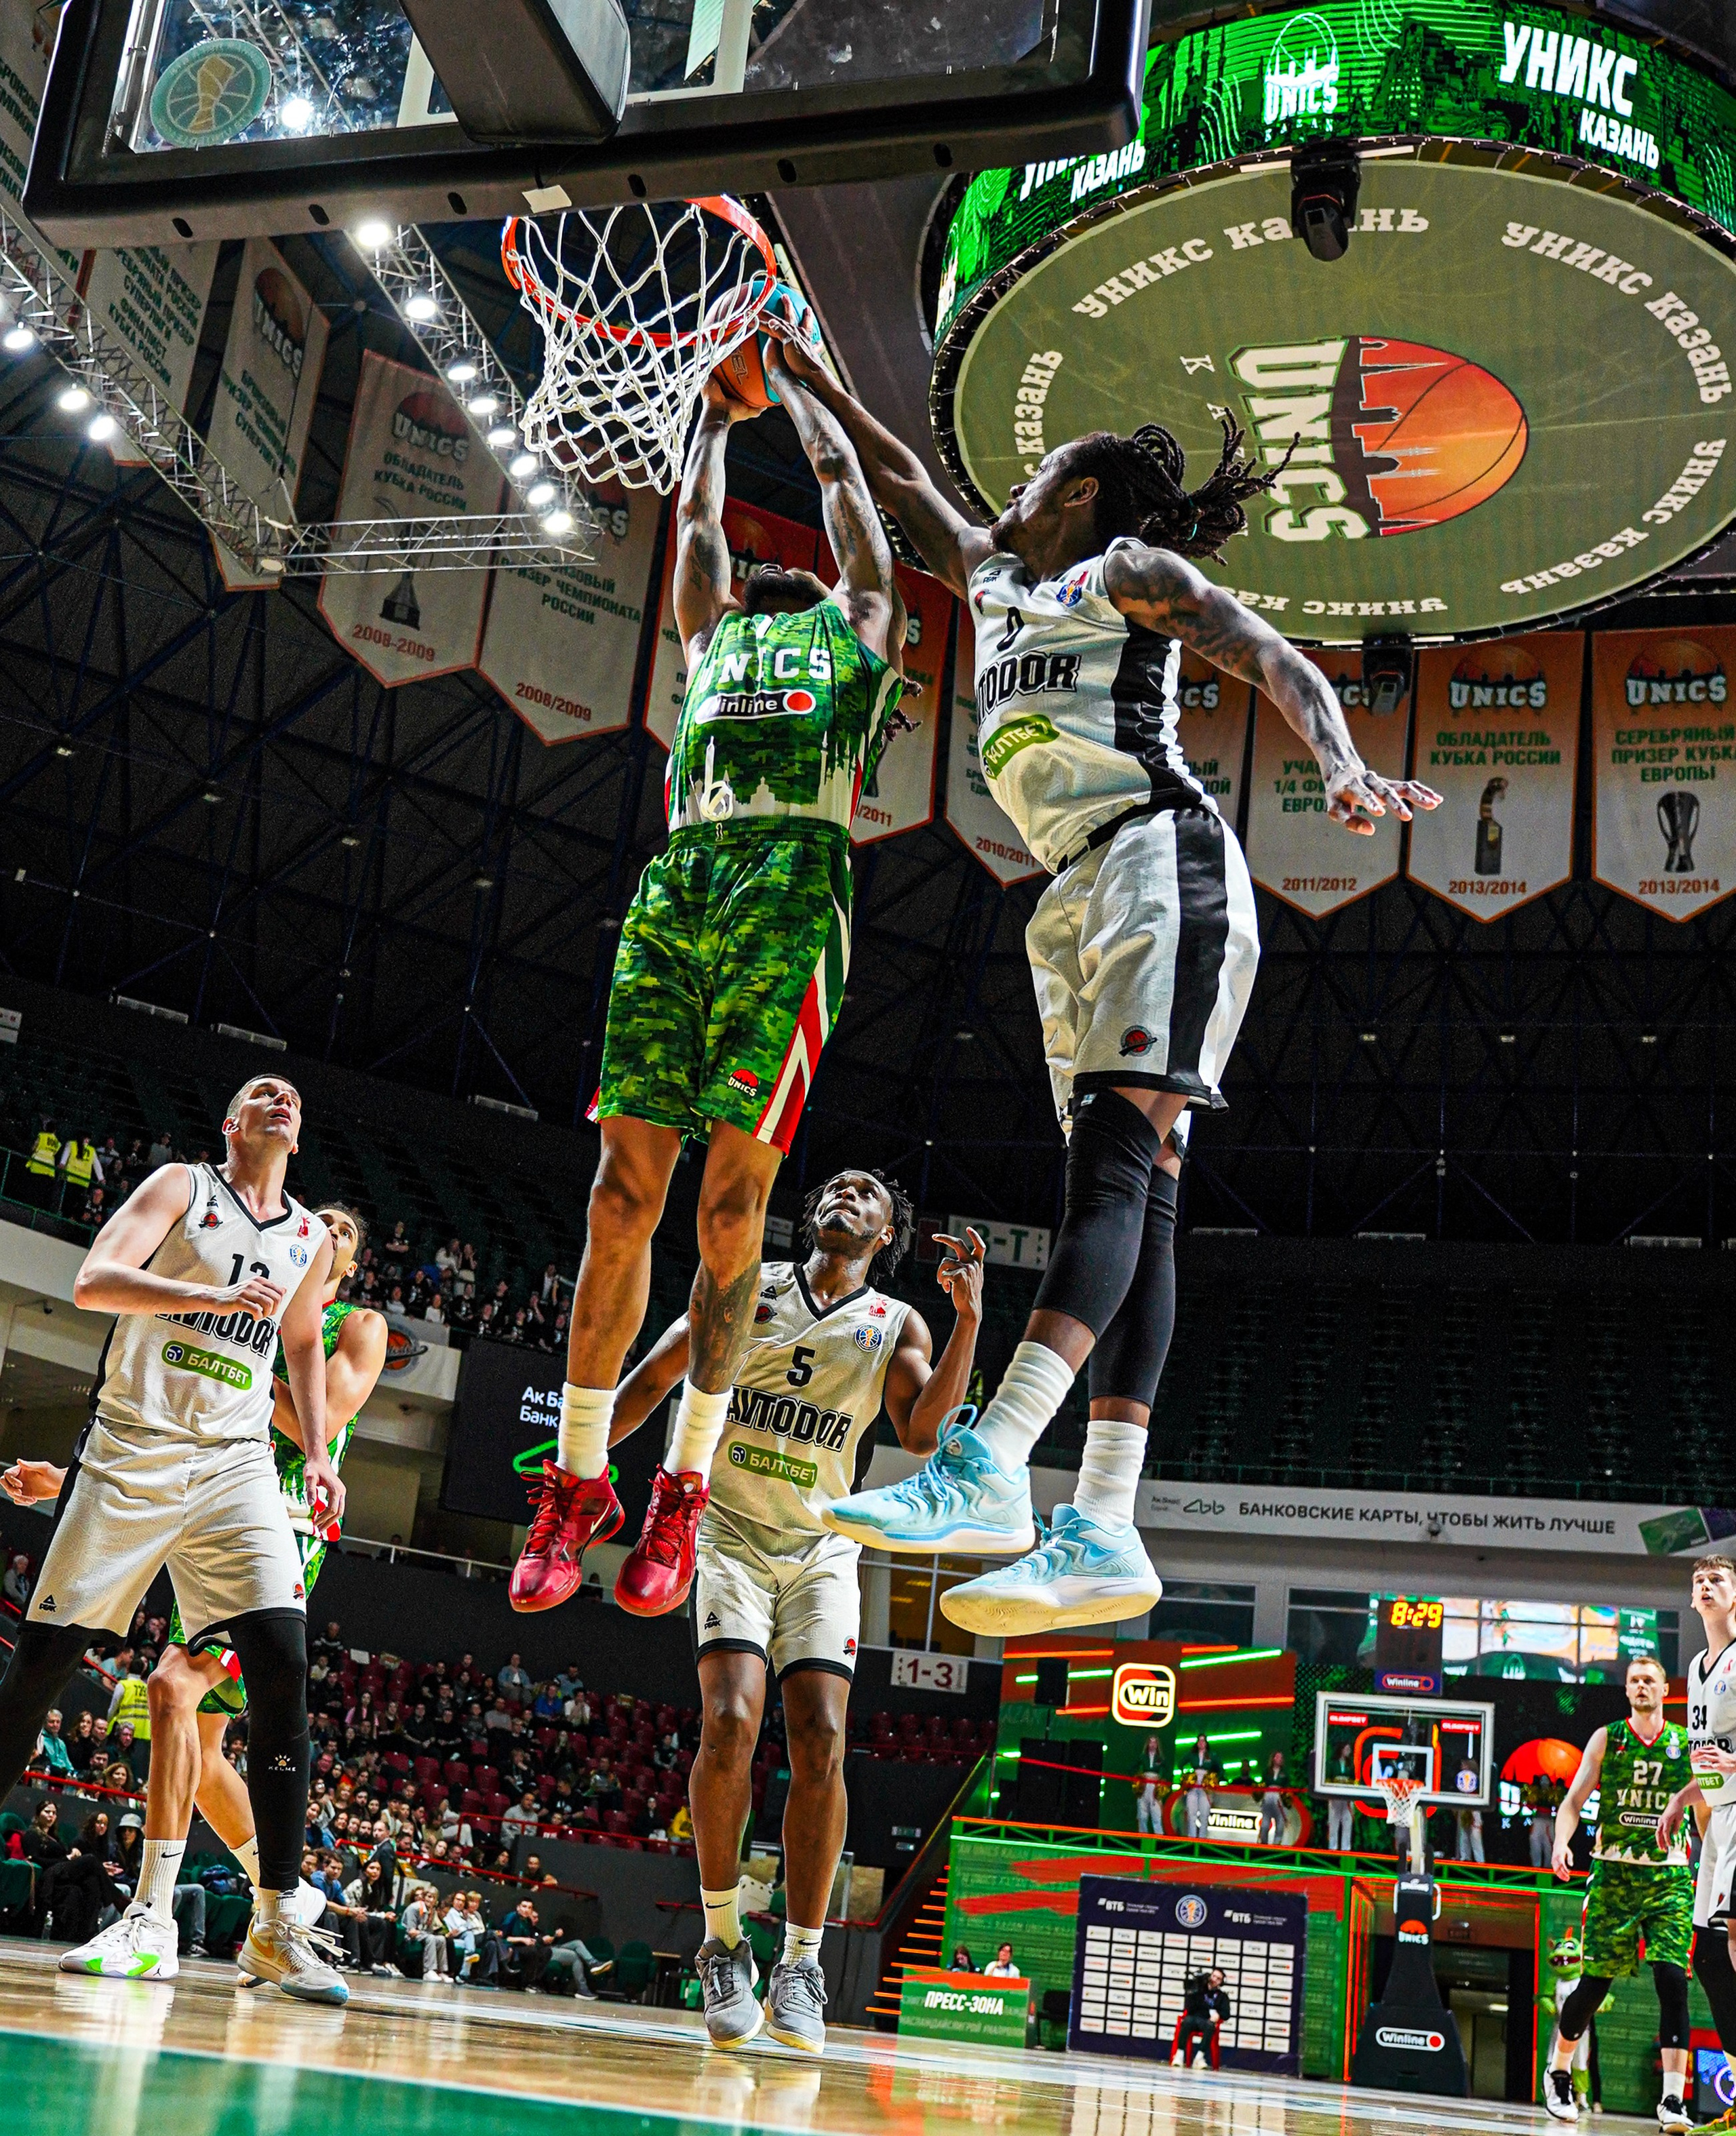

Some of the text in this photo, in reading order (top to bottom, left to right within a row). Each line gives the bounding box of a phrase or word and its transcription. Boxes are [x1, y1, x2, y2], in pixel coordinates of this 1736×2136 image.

[1499, 21, 1638, 117] УНИКС
[1263, 73, 1339, 125] UNICS
[1580, 108, 1660, 170] КАЗАНЬ
[1070, 140, 1146, 203] КАЗАНЬ
[1224, 208, 1429, 250] кань
[393, 411, 470, 462] UNICS
[1229, 336, 1370, 542] UNICS
[374, 471, 467, 512] КУБКА РОССИИ
[542, 593, 595, 625] РОССИИ
[556, 580, 641, 622] ЧЕМПИОНАТА
[351, 624, 435, 662] 2008-2009
[515, 682, 592, 723] 2008/2009
[1451, 680, 1546, 708] UNICS
[1627, 675, 1727, 706] UNICS
[717, 697, 778, 714] inline
[1436, 731, 1552, 749] ОБЛАДАТЕЛЬ
[1615, 725, 1735, 745] СЕРЕБРЯНЫЙ
[1431, 751, 1560, 765] КУБКА РОССИИ
[1612, 747, 1679, 764] ПРИЗЕР
[1641, 766, 1716, 782] ЕВРОПЫ
[1275, 780, 1296, 795] 1/4
[856, 804, 892, 827] /2011
[1282, 877, 1357, 892] 2011/2012
[1448, 879, 1527, 895] 2013/2014
[1638, 878, 1720, 894] 2013/2014
[728, 1077, 757, 1097] UNICS
[187, 1352, 249, 1385] БАЛТБЕТ
[786, 1345, 815, 1387] 5
[521, 1386, 564, 1409] Ак Ба
[519, 1405, 557, 1427] Банк
[726, 1384, 853, 1452] AVTODOR
[1239, 1501, 1616, 1534] БАНКОВСКИЕ КАРТЫ, ЧТОБЫ ЖИТЬ ЛУЧШЕ
[39, 1603, 57, 1613] PEAK
[1390, 1601, 1443, 1628] 8:29
[704, 1619, 721, 1629] PEAK
[907, 1657, 953, 1688] 1-3
[1386, 1678, 1420, 1688] Winline
[1127, 1685, 1169, 1707] Win
[1692, 1705, 1708, 1730] 34
[1633, 1760, 1663, 1786] 27
[1623, 1815, 1657, 1825] Winline
[1105, 1900, 1125, 1912] ВТБ
[1231, 1912, 1252, 1924] ВТБ
[1398, 1931, 1429, 1945] UNICS
[924, 1990, 1004, 2015] ПРЕСС-ЗОНА
[1382, 2031, 1425, 2046] Winline
